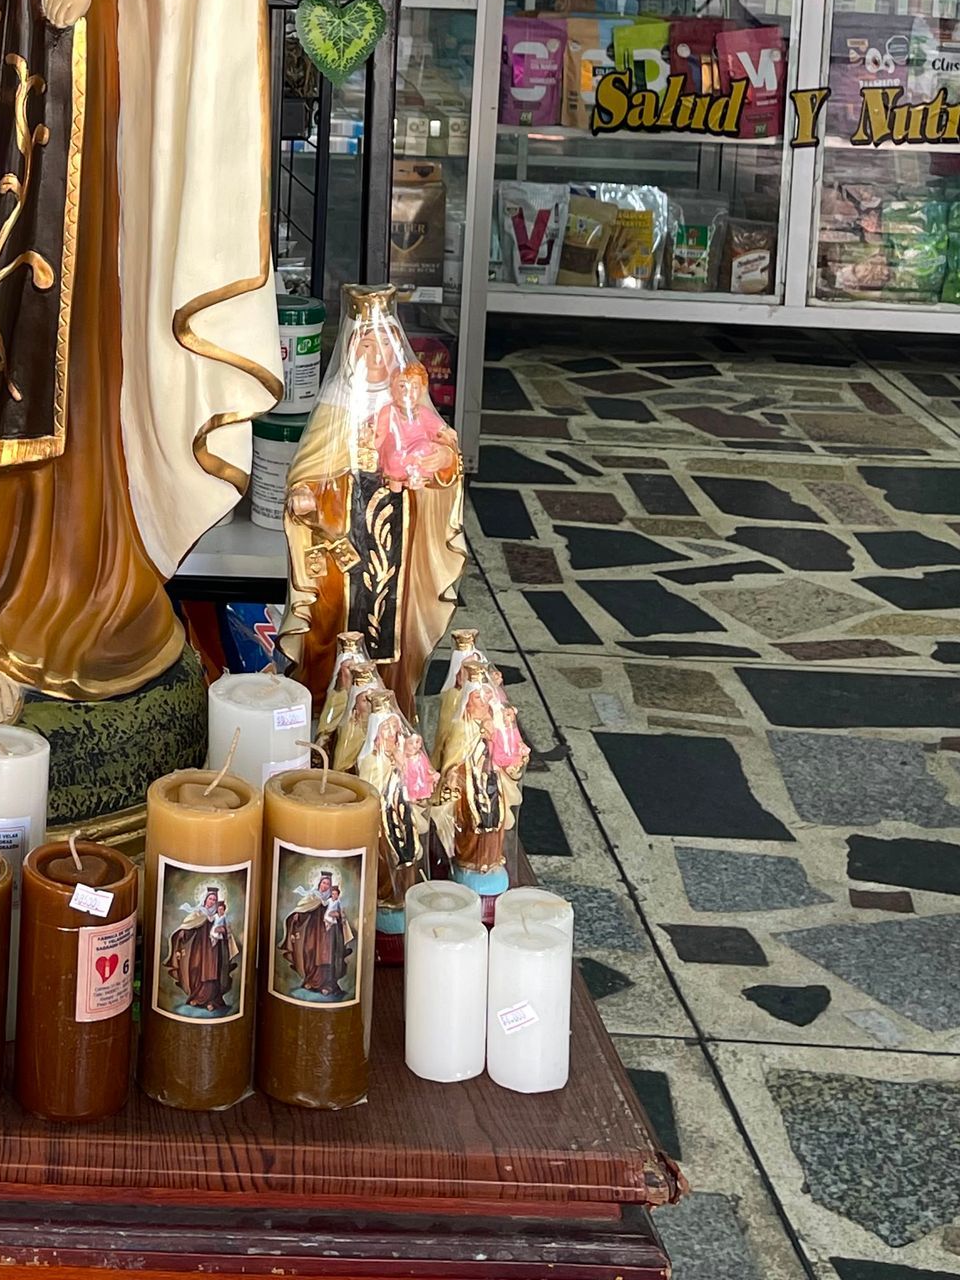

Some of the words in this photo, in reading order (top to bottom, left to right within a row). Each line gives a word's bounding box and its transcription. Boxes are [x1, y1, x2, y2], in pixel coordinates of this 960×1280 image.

[592, 67, 749, 137] Salud
[790, 87, 831, 148] Y
[122, 958, 130, 974] 6
